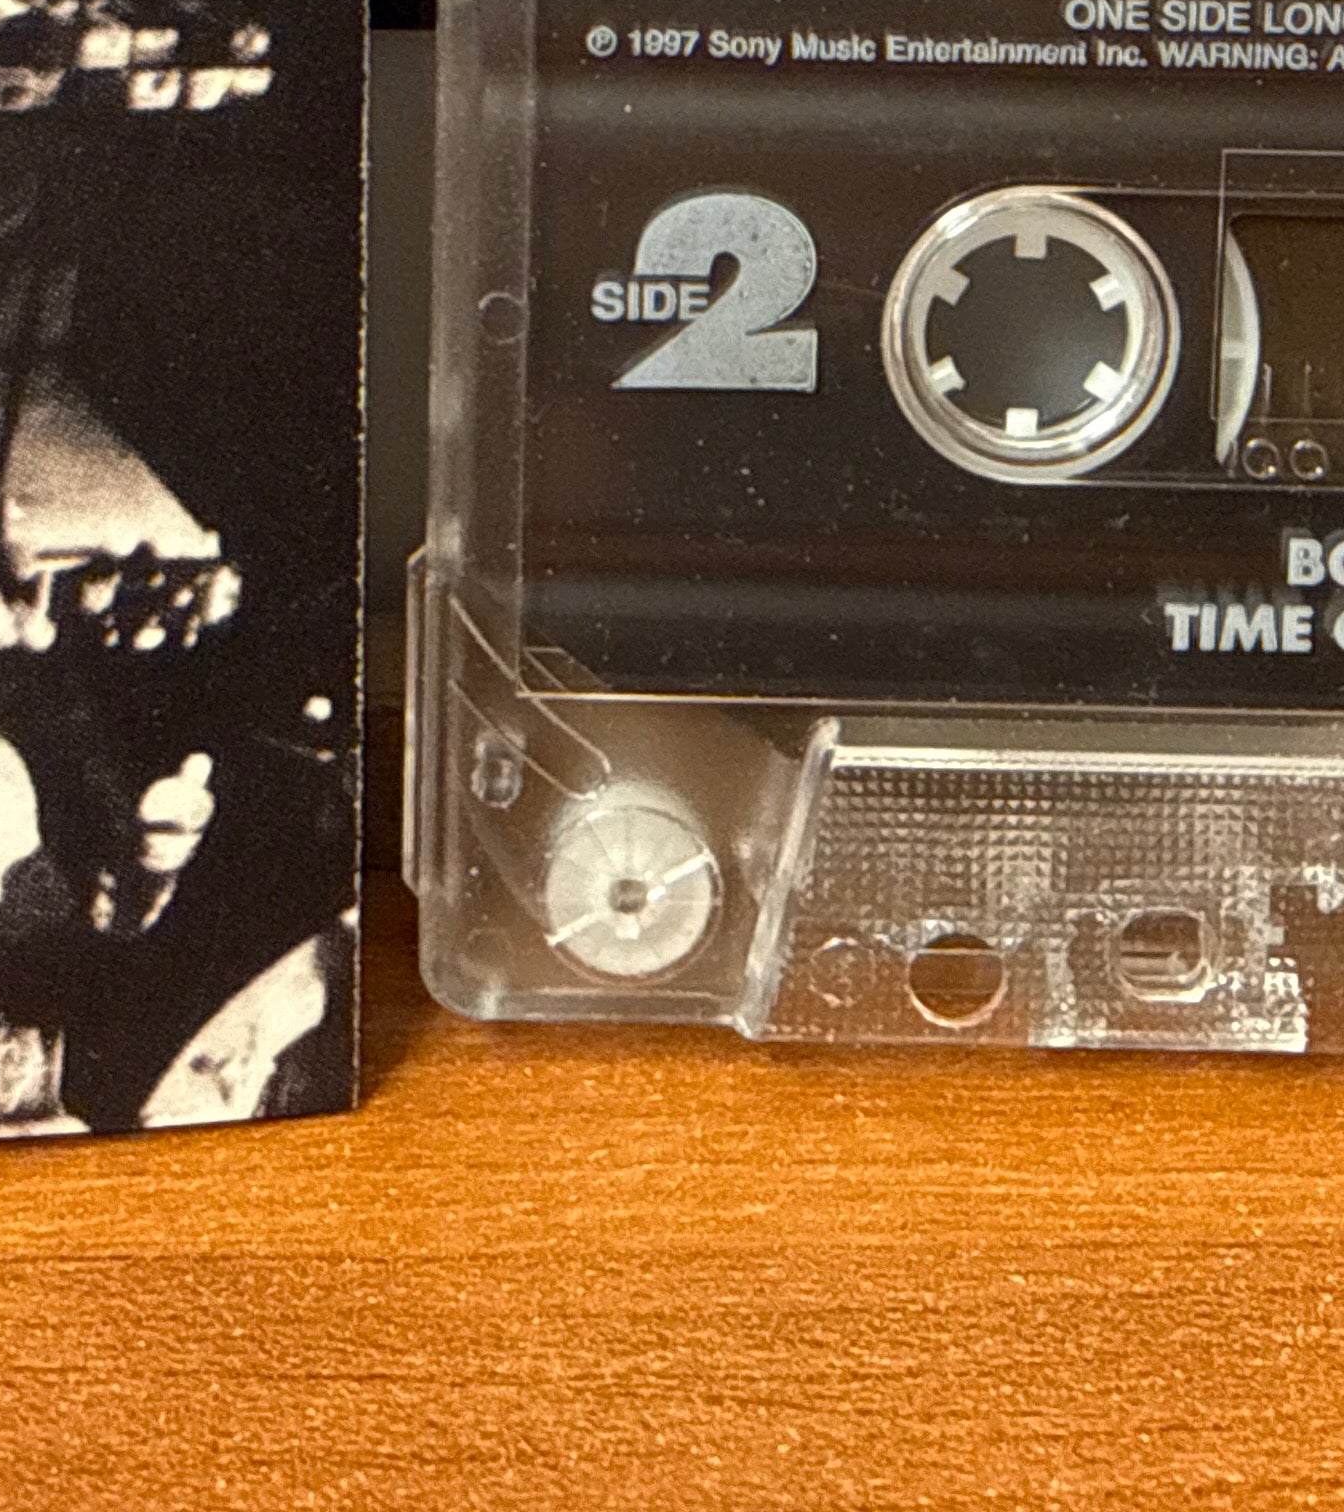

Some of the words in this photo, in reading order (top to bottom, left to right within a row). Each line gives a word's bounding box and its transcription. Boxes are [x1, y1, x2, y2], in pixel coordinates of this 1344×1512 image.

[627, 28, 700, 57] 1997
[707, 29, 783, 65] Sony
[791, 31, 877, 63] Music
[885, 33, 1088, 66] Entertainment
[1097, 40, 1149, 67] Inc.
[1157, 40, 1318, 71] WARNING:
[590, 280, 711, 322] SIDE
[610, 193, 818, 393] 2
[1164, 602, 1314, 653] TIME
